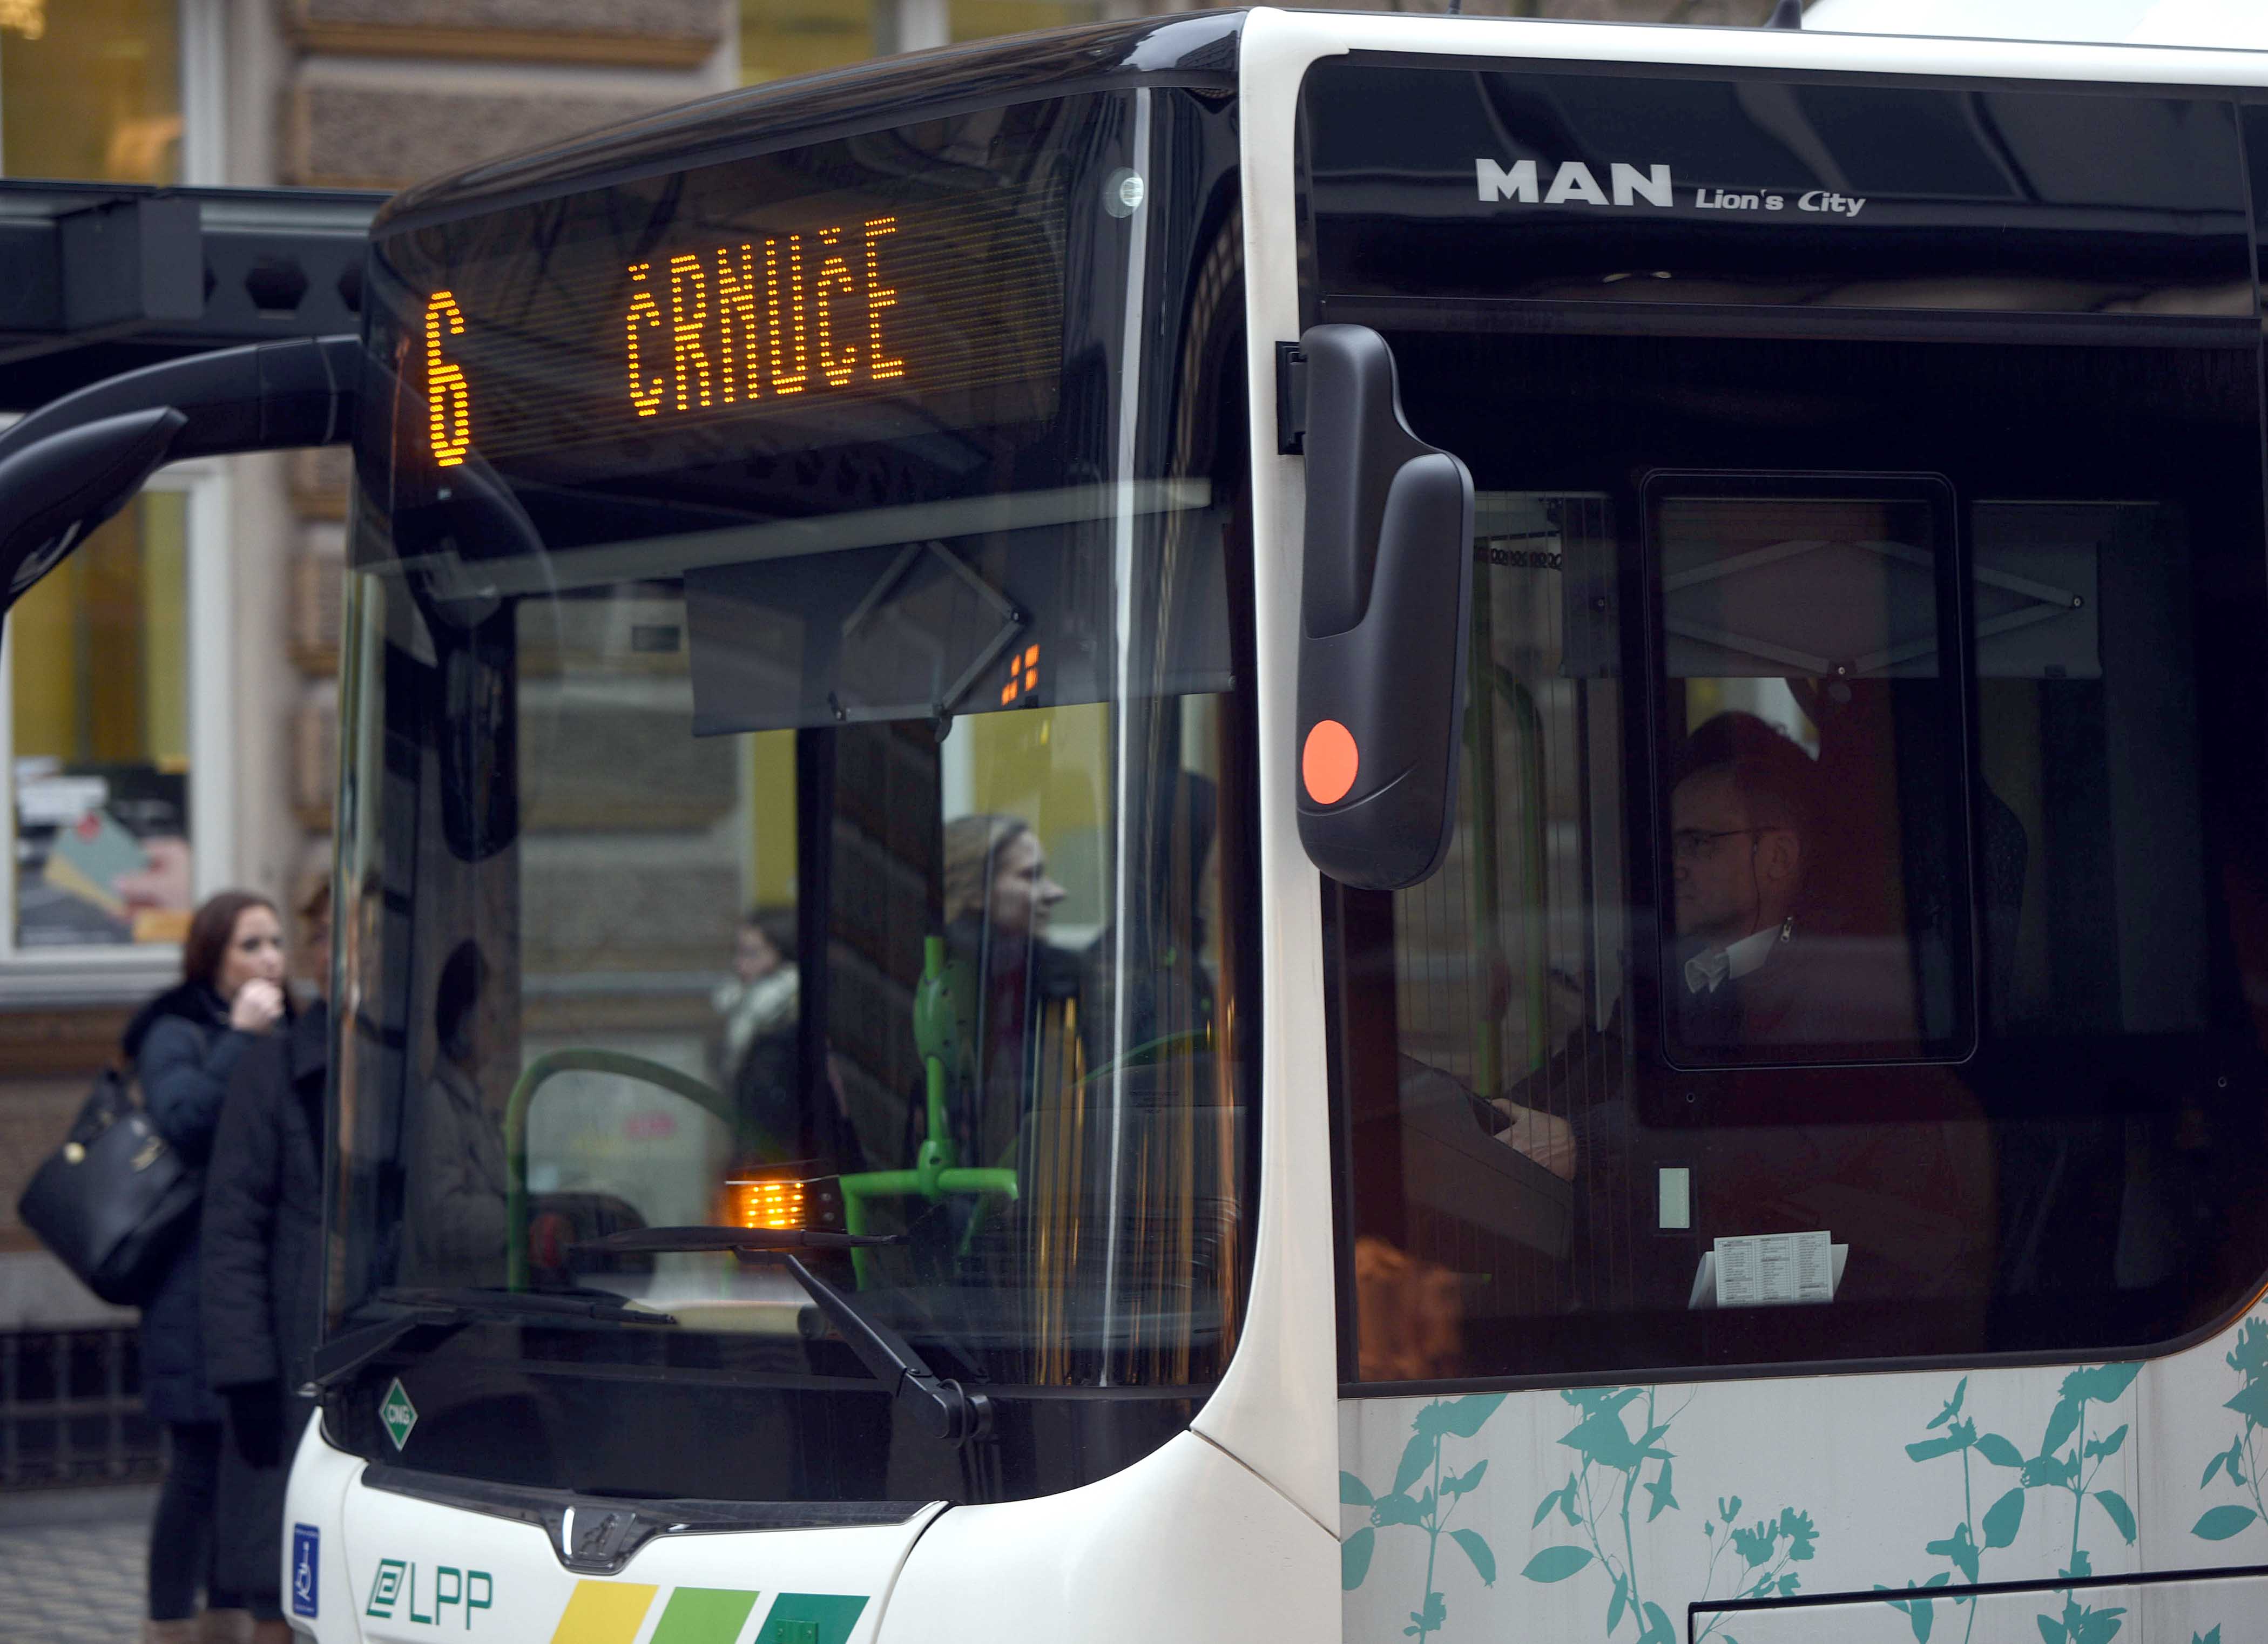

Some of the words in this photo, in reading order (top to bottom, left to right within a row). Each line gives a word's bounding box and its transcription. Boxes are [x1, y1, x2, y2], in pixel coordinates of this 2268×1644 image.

[1475, 158, 1673, 207] MAN
[1695, 188, 1784, 211] Lion's
[1798, 190, 1866, 218] City
[426, 290, 471, 468] 6
[626, 217, 905, 417] ČRNUČE
[387, 1404, 410, 1424] CNG
